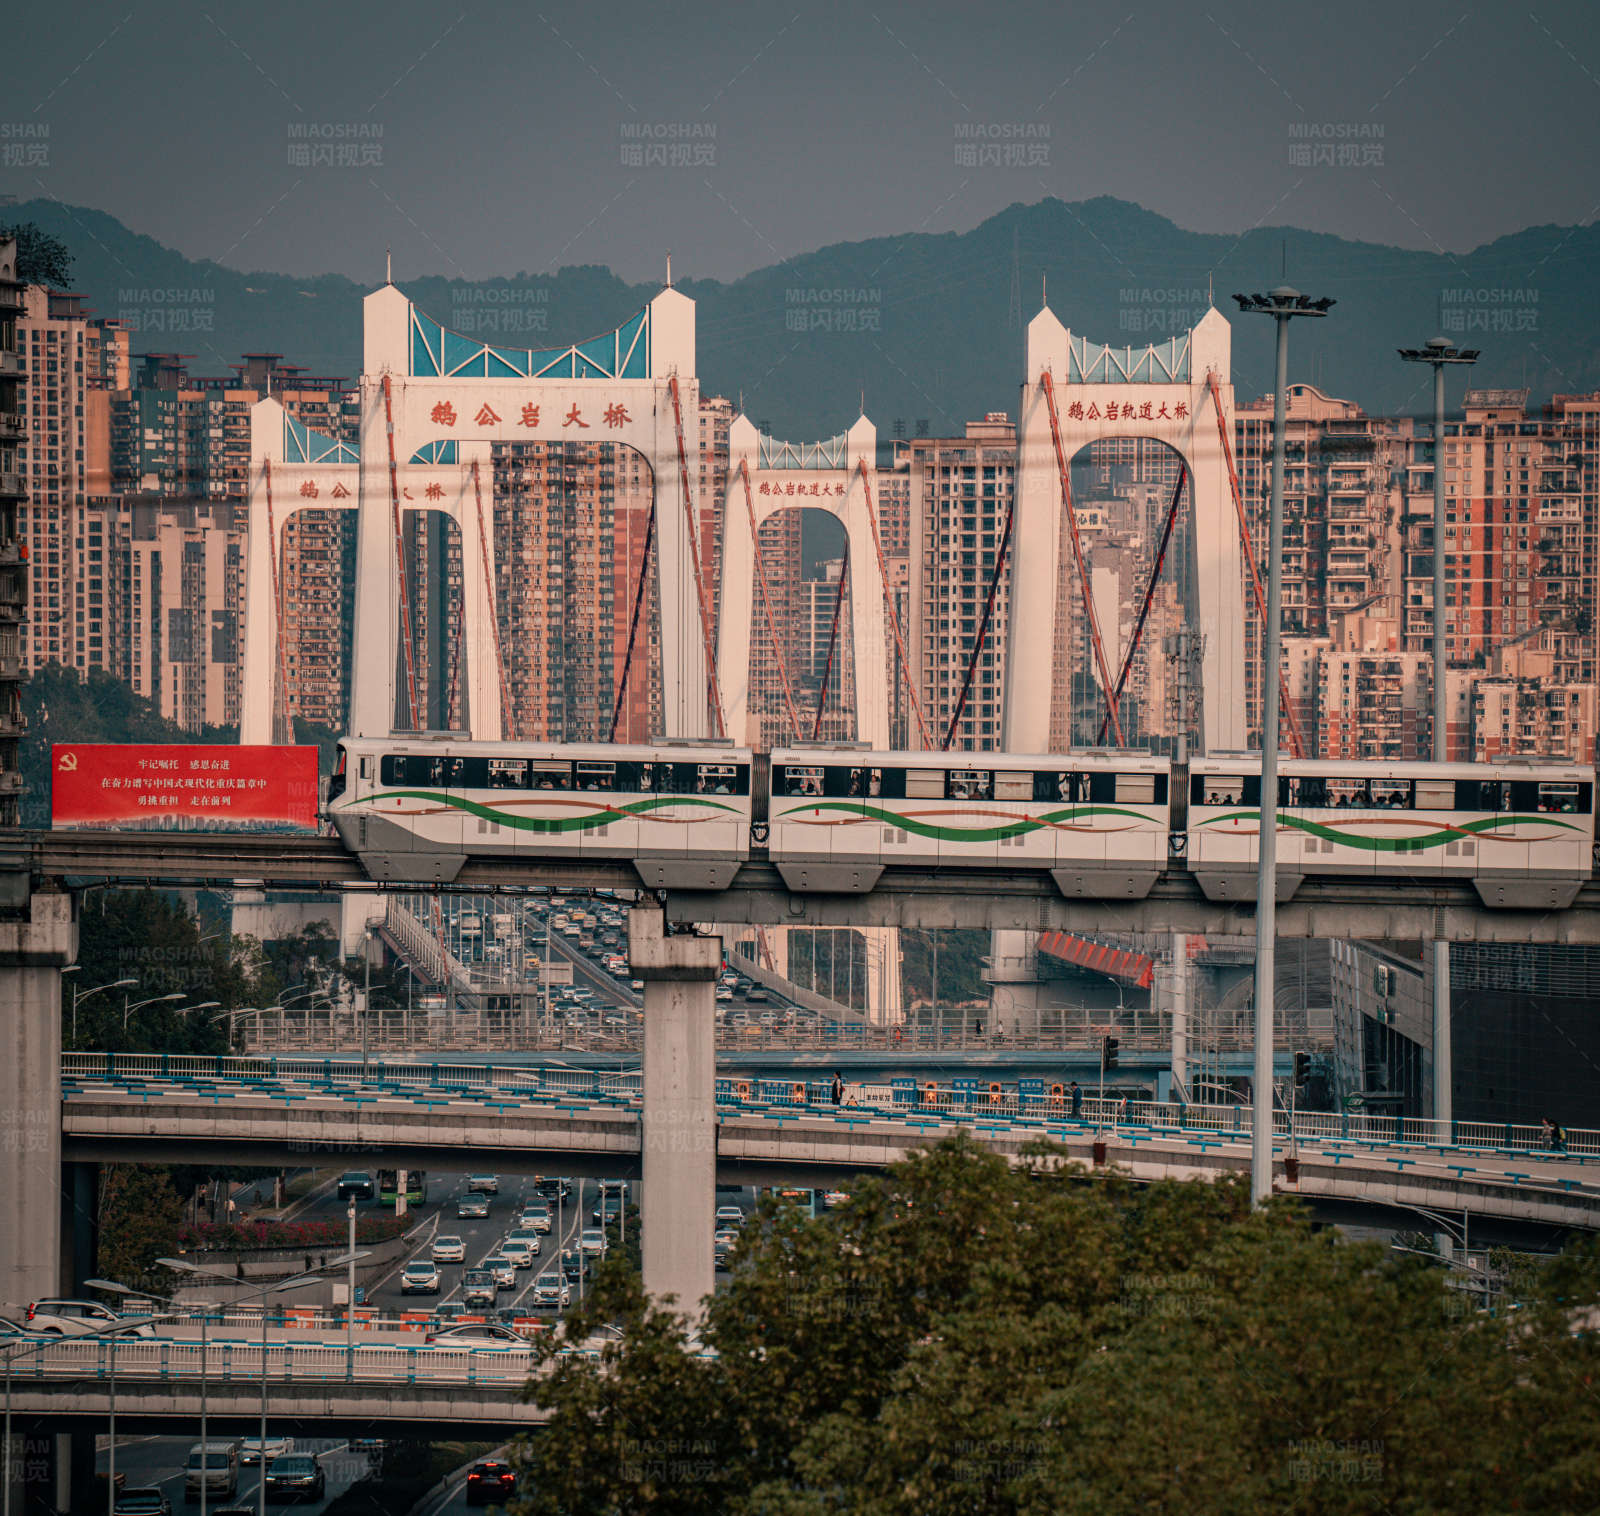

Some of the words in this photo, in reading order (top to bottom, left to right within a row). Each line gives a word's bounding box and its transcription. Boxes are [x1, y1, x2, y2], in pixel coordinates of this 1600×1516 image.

[430, 400, 632, 429] 鹅公岩大桥
[1067, 400, 1190, 421] 鹅公岩轨道大桥
[759, 481, 846, 497] 鹅公岩轨道大桥
[138, 759, 180, 770] 牢记嘱托
[189, 759, 231, 770] 感恩奋进
[138, 795, 179, 806] 勇挑重担
[189, 795, 232, 807] 走在前列
